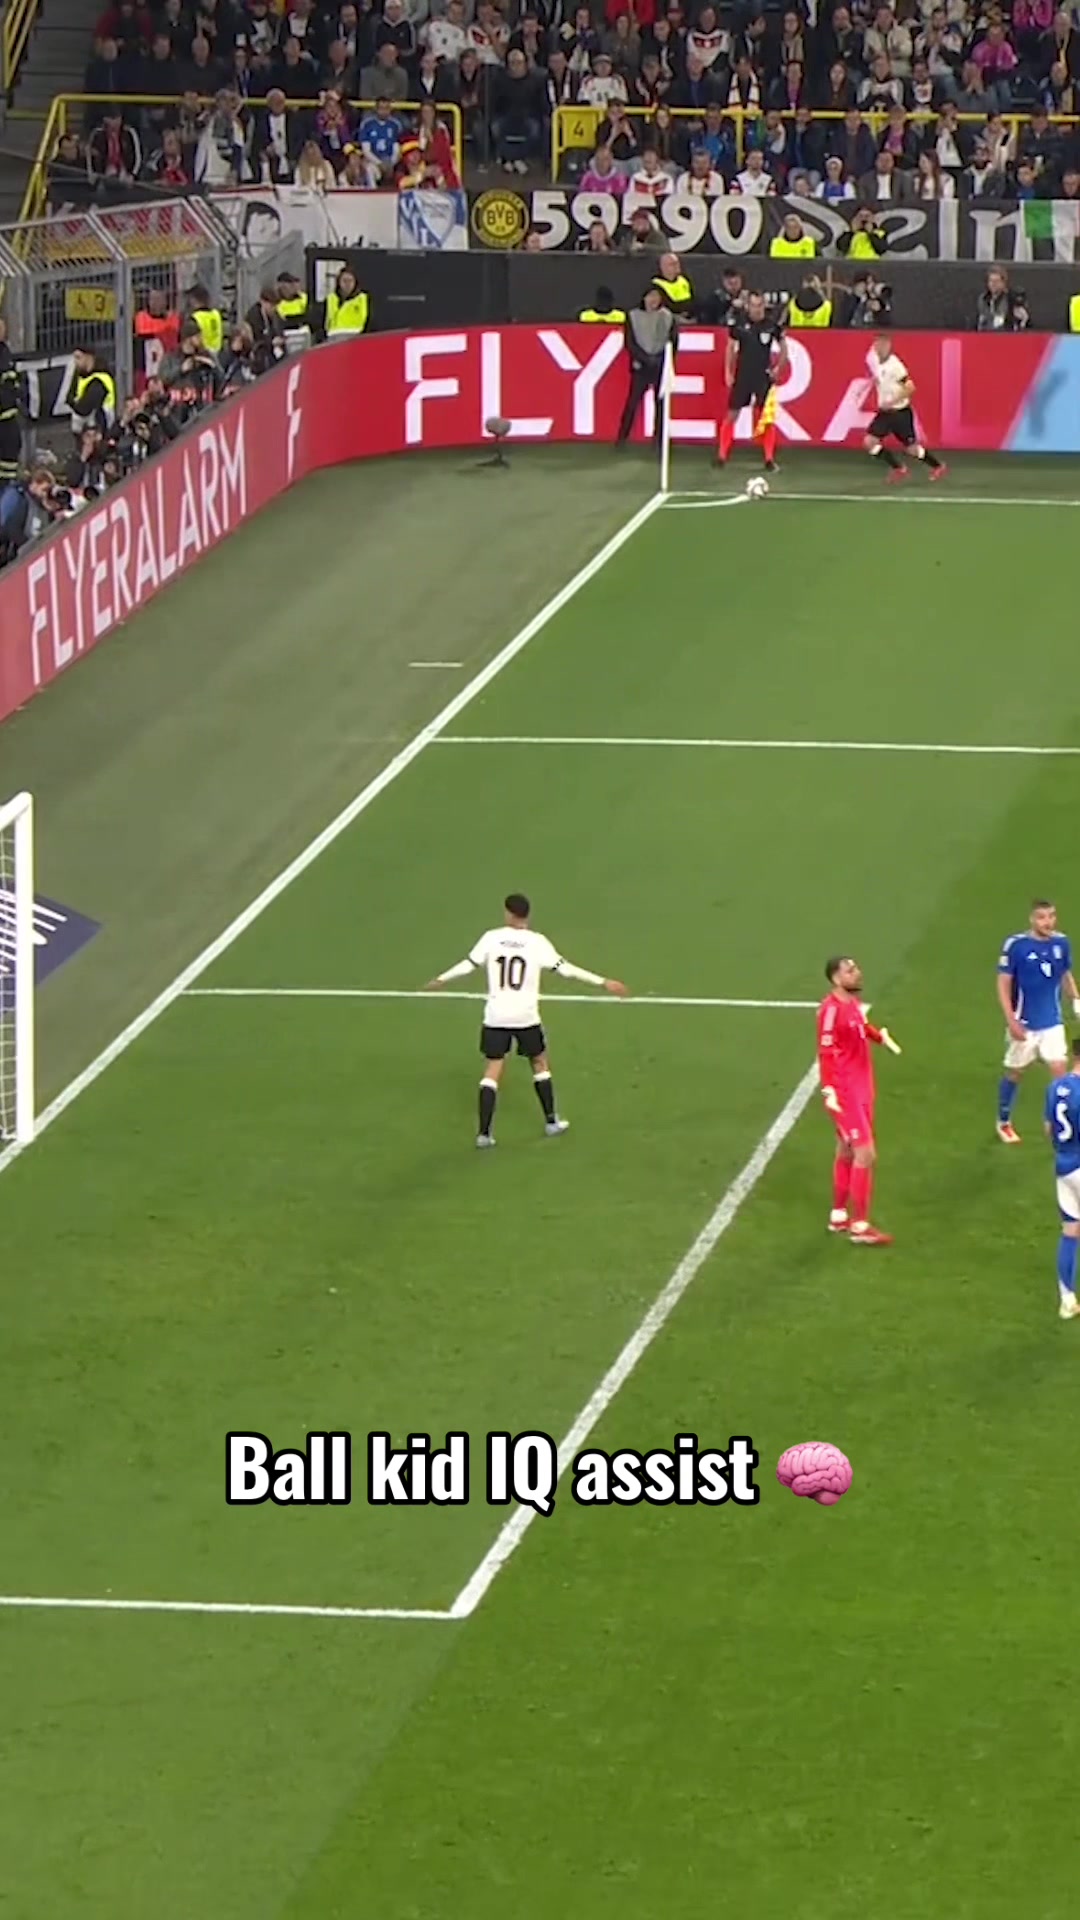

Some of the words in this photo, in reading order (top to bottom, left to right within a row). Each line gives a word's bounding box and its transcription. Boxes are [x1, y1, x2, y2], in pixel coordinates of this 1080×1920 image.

[573, 120, 584, 137] 4
[487, 203, 515, 226] BVB
[531, 190, 763, 255] 59590
[27, 407, 248, 686] FLYERALARM
[496, 955, 527, 991] 10
[1056, 1101, 1072, 1142] 5
